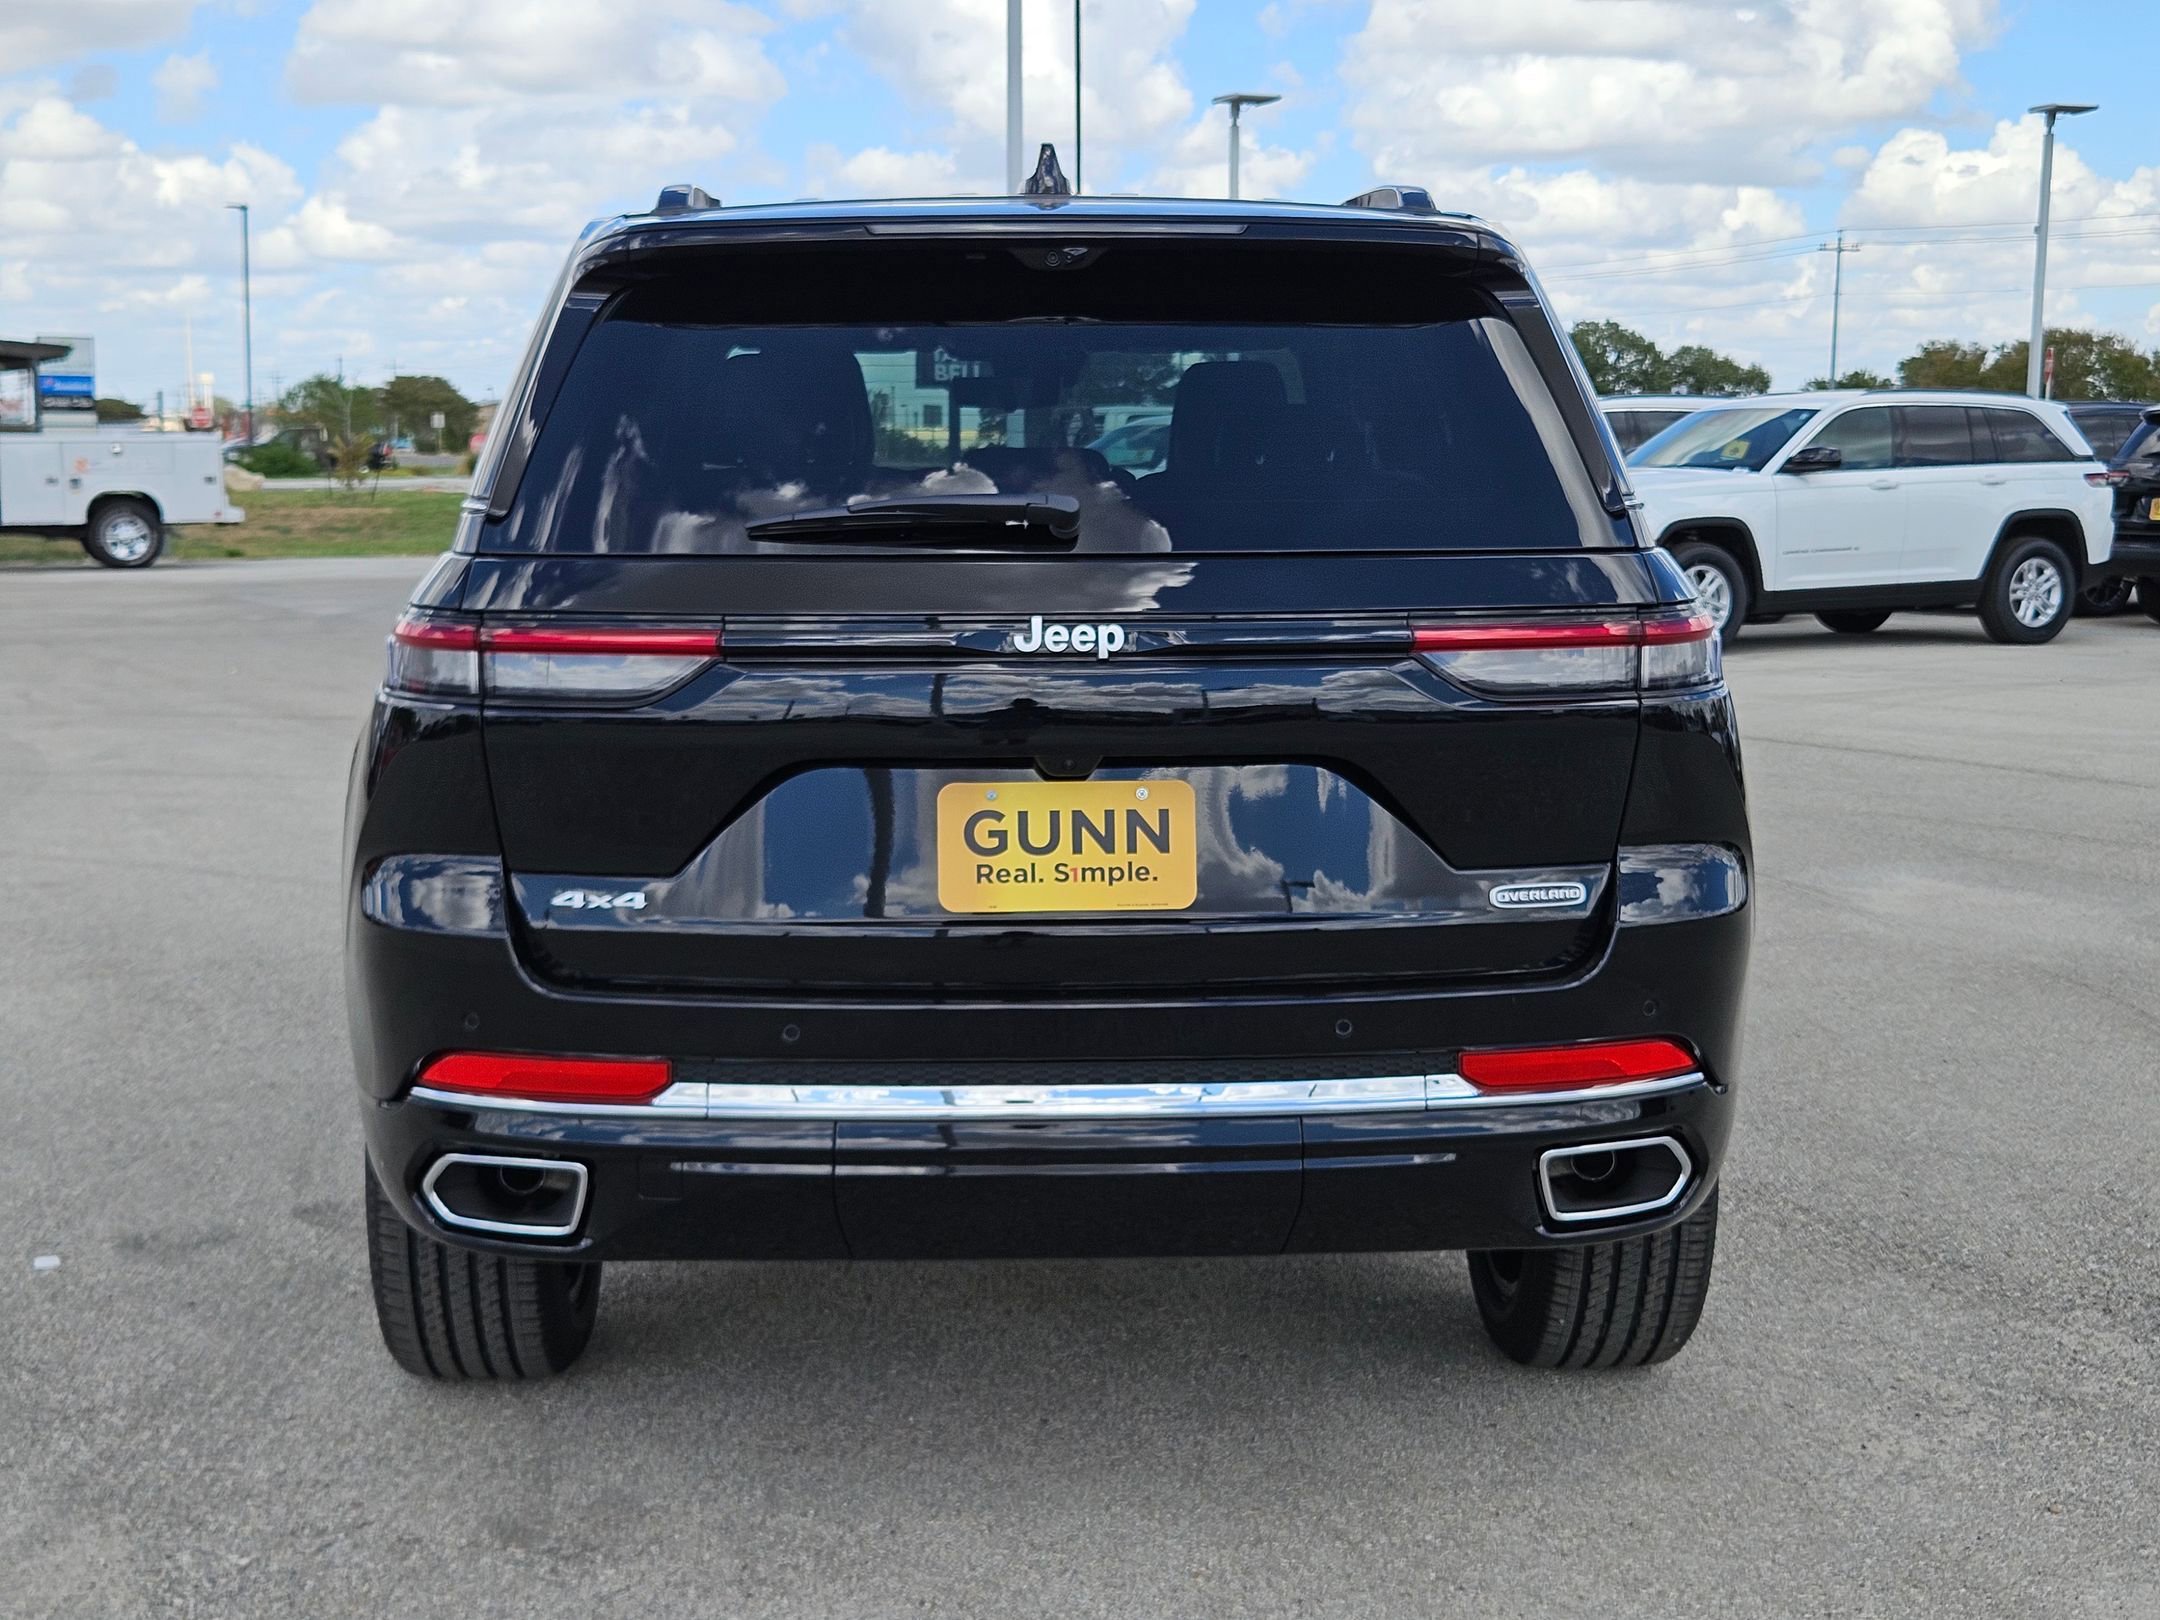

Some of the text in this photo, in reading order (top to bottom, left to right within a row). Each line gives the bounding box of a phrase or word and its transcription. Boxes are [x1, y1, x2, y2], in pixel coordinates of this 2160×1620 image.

[1013, 616, 1125, 659] Jeep
[963, 808, 1171, 857] GUNN
[975, 862, 1044, 885] Real.
[550, 890, 648, 910] 4x4
[1496, 887, 1581, 903] OVERLAND
